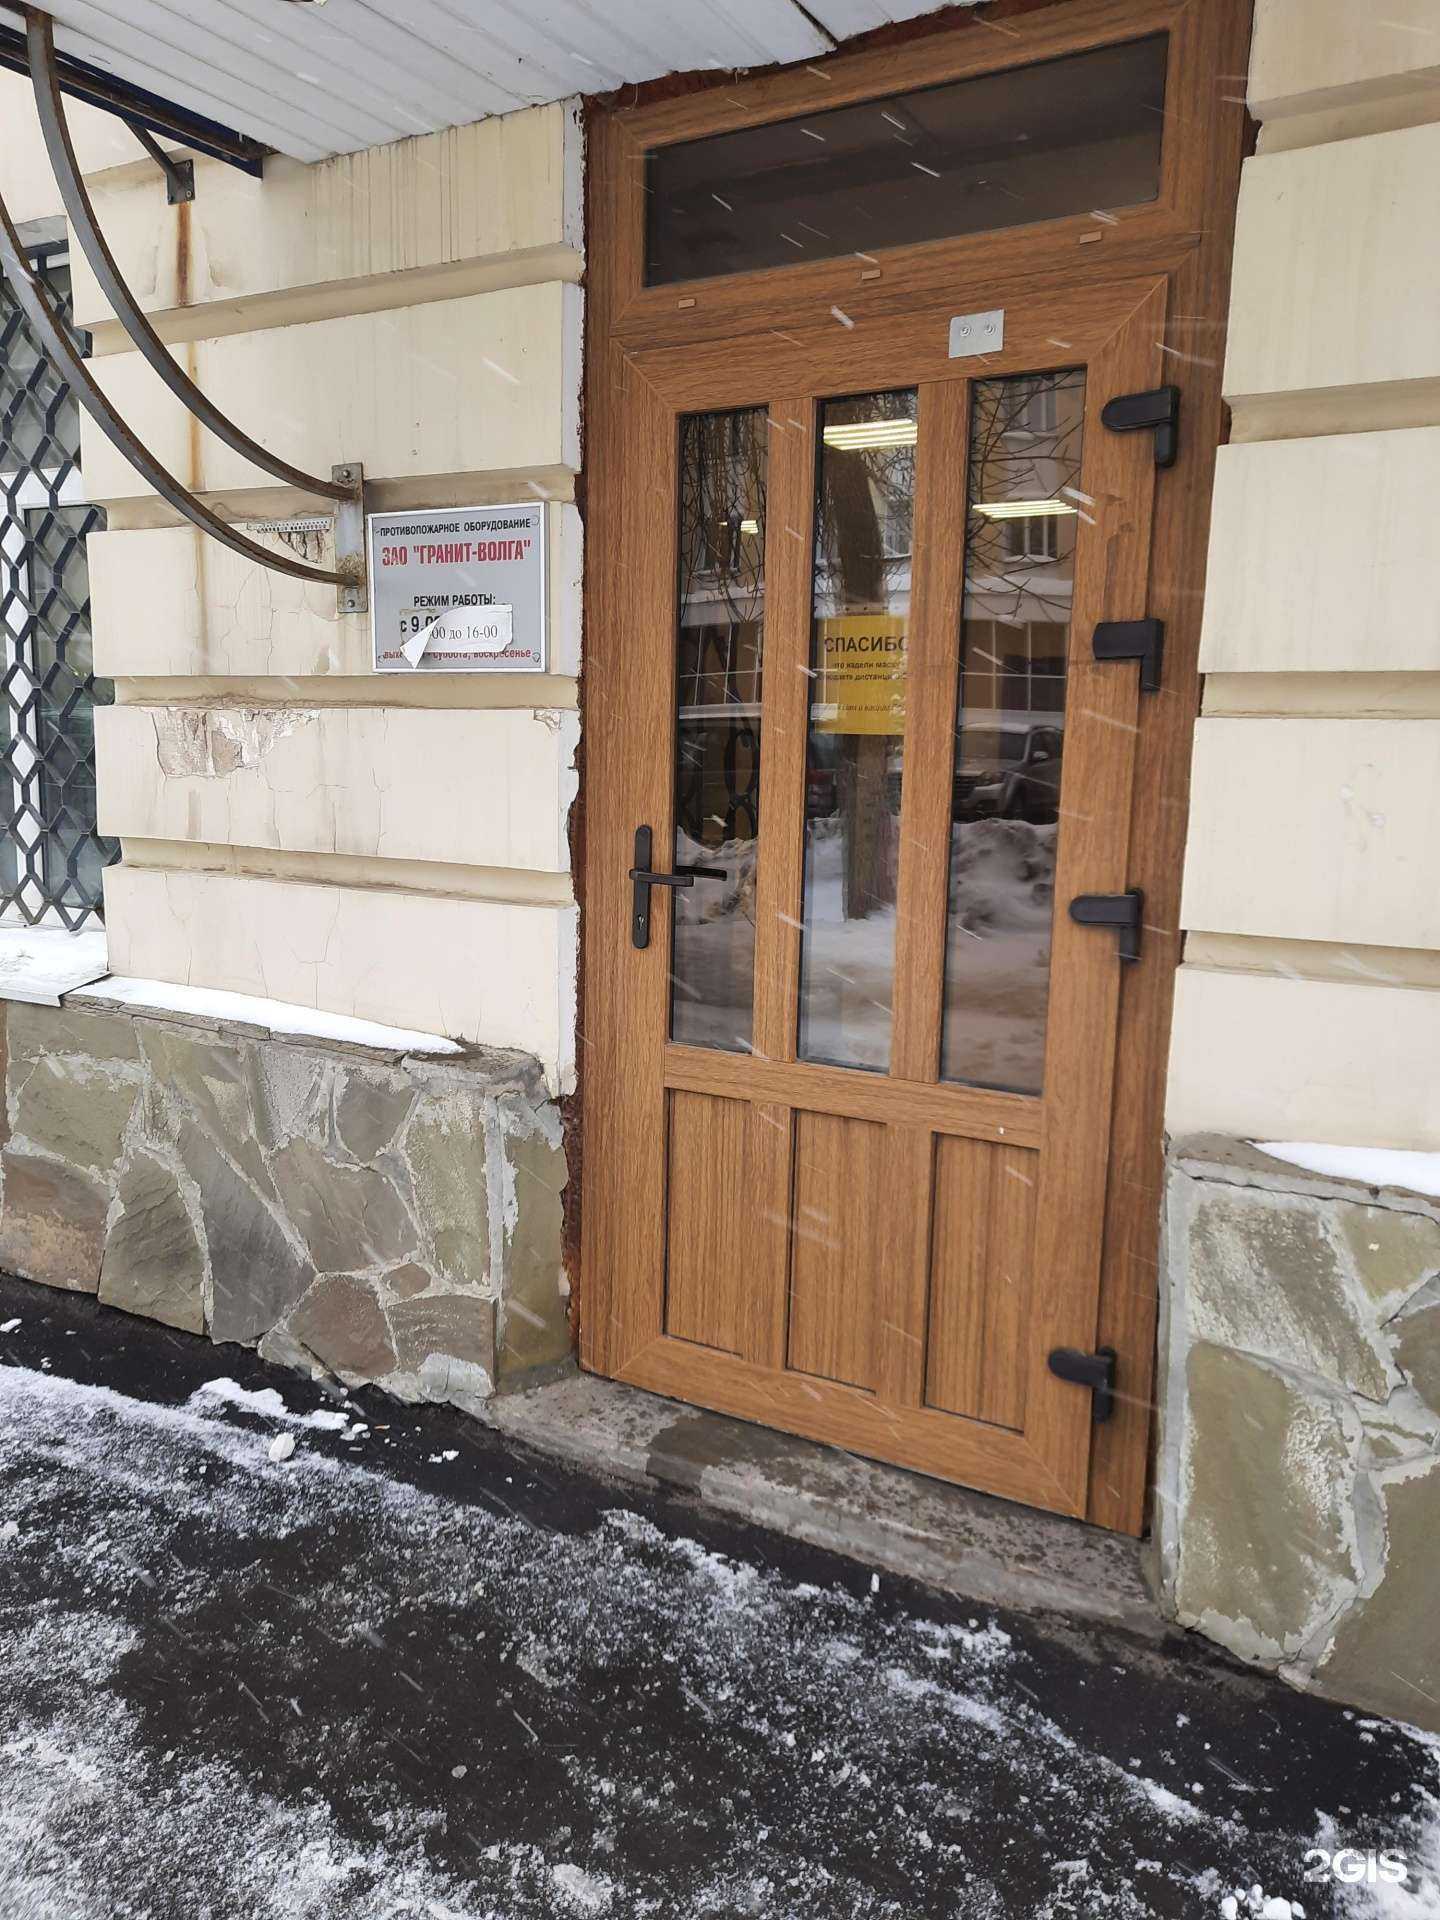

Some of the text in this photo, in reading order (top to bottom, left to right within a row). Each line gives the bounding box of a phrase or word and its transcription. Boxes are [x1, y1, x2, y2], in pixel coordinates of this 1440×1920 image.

[380, 518, 531, 537] ПРОТИВОПОЖАРНОЕ ОБОРУДОВАНИЕ
[382, 539, 531, 566] ЗАО "ГРАНИТ-ВОЛГА"
[414, 593, 496, 607] РЕЖИМ РАБОТЫ:
[449, 629, 462, 640] до
[466, 625, 498, 639] 16-00
